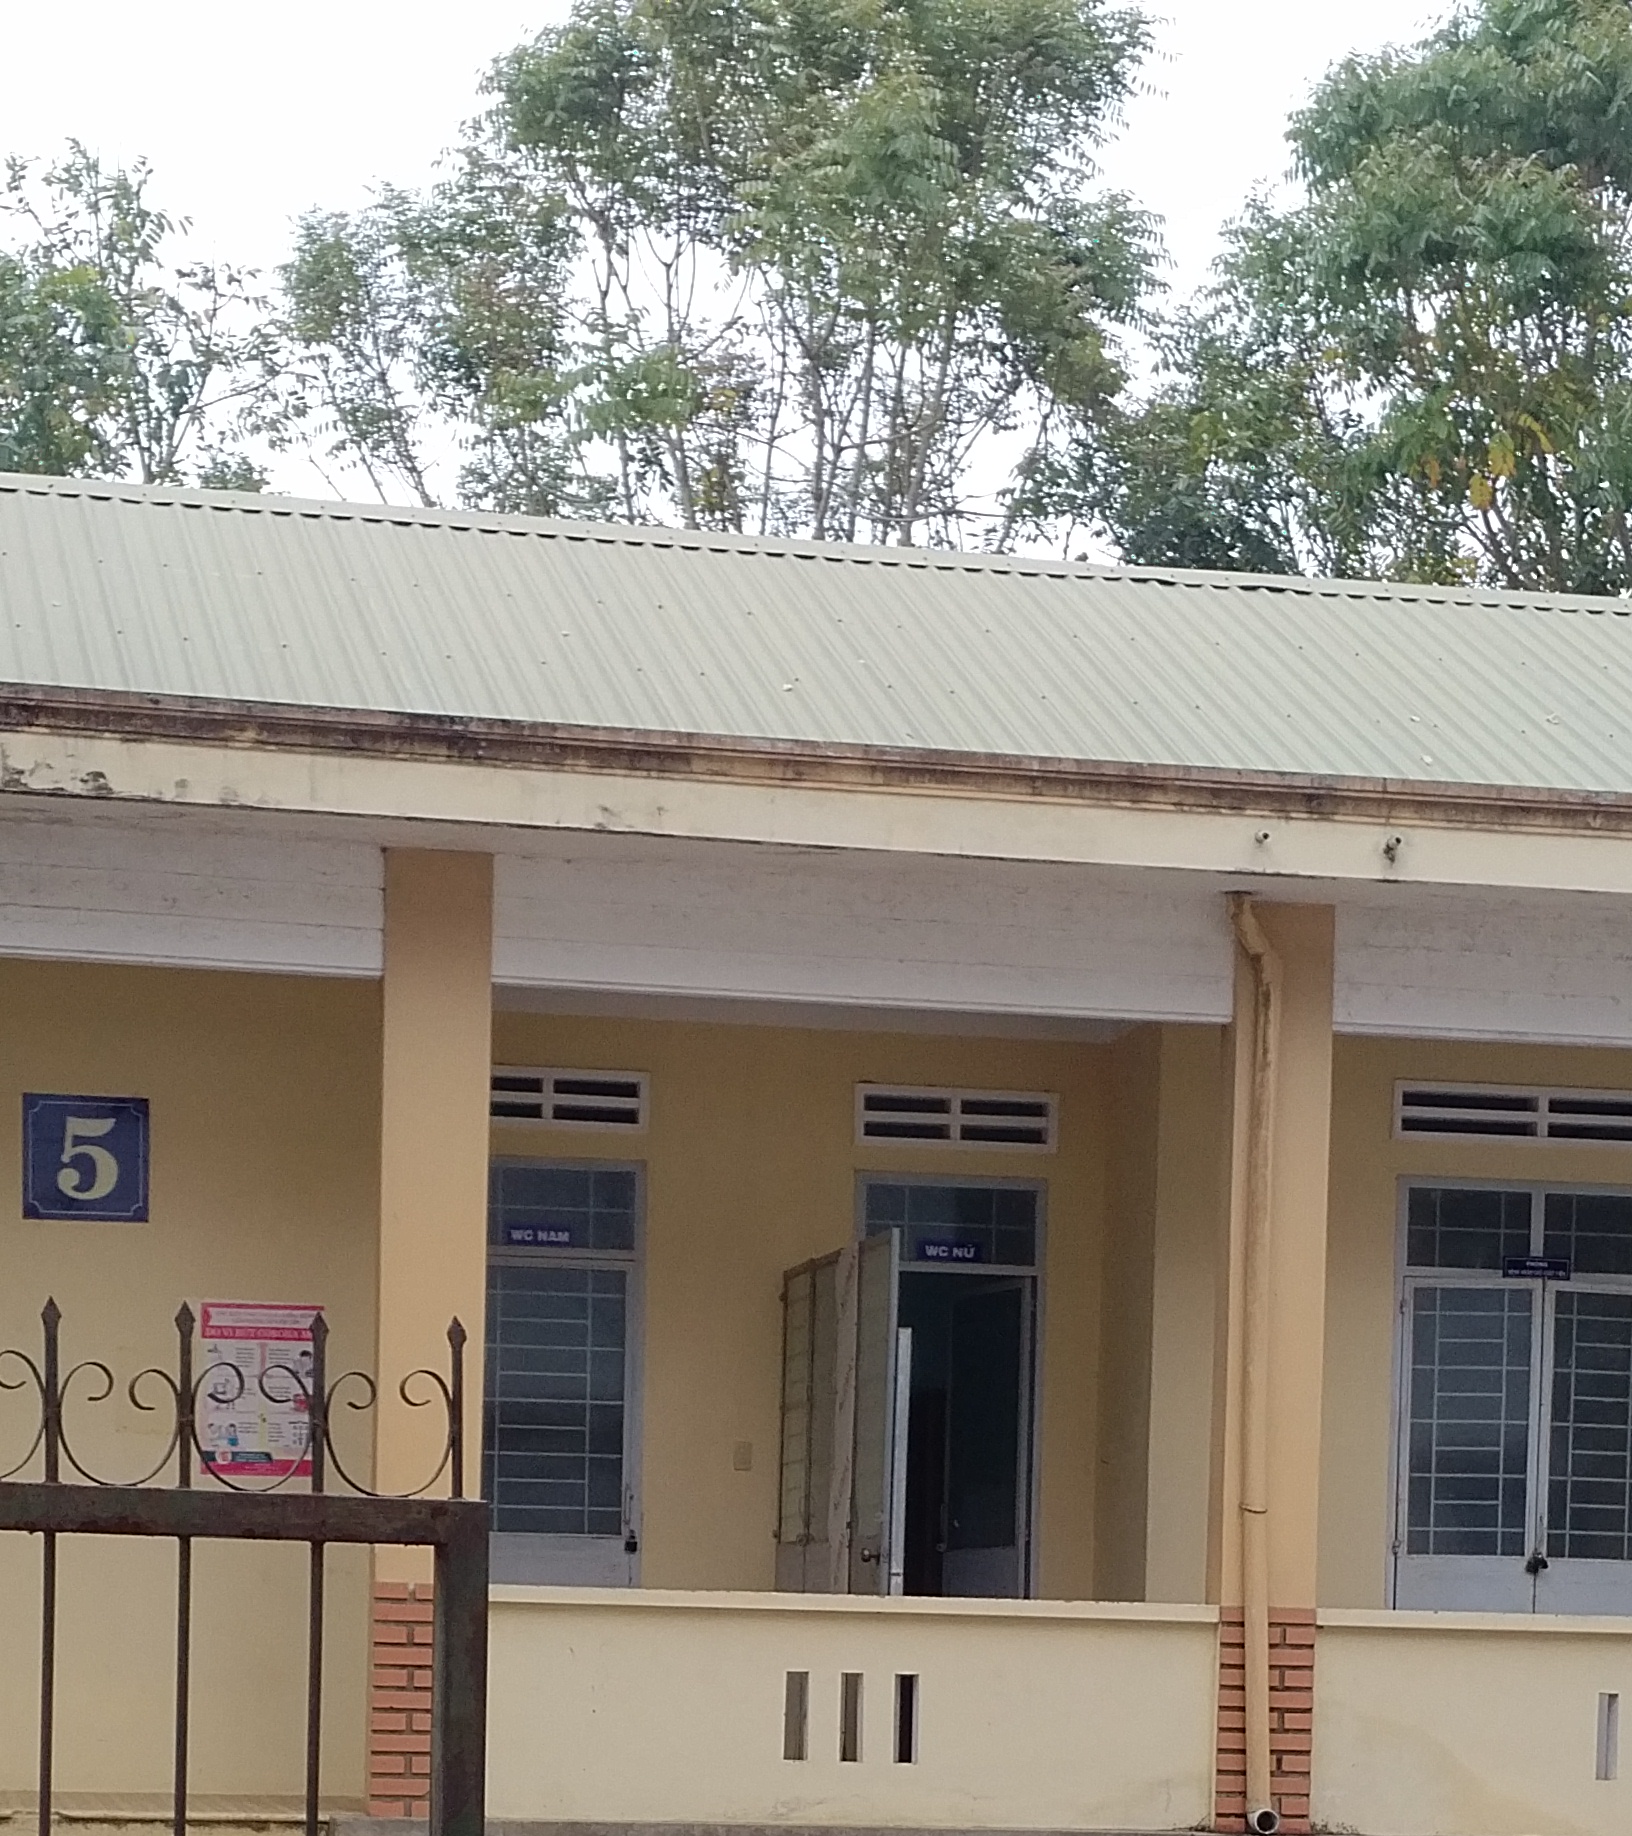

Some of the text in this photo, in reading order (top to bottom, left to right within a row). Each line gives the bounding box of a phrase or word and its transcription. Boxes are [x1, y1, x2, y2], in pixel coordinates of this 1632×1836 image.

[56, 1115, 119, 1201] 5
[510, 1229, 570, 1242] WC NAM
[924, 1245, 948, 1257] WC
